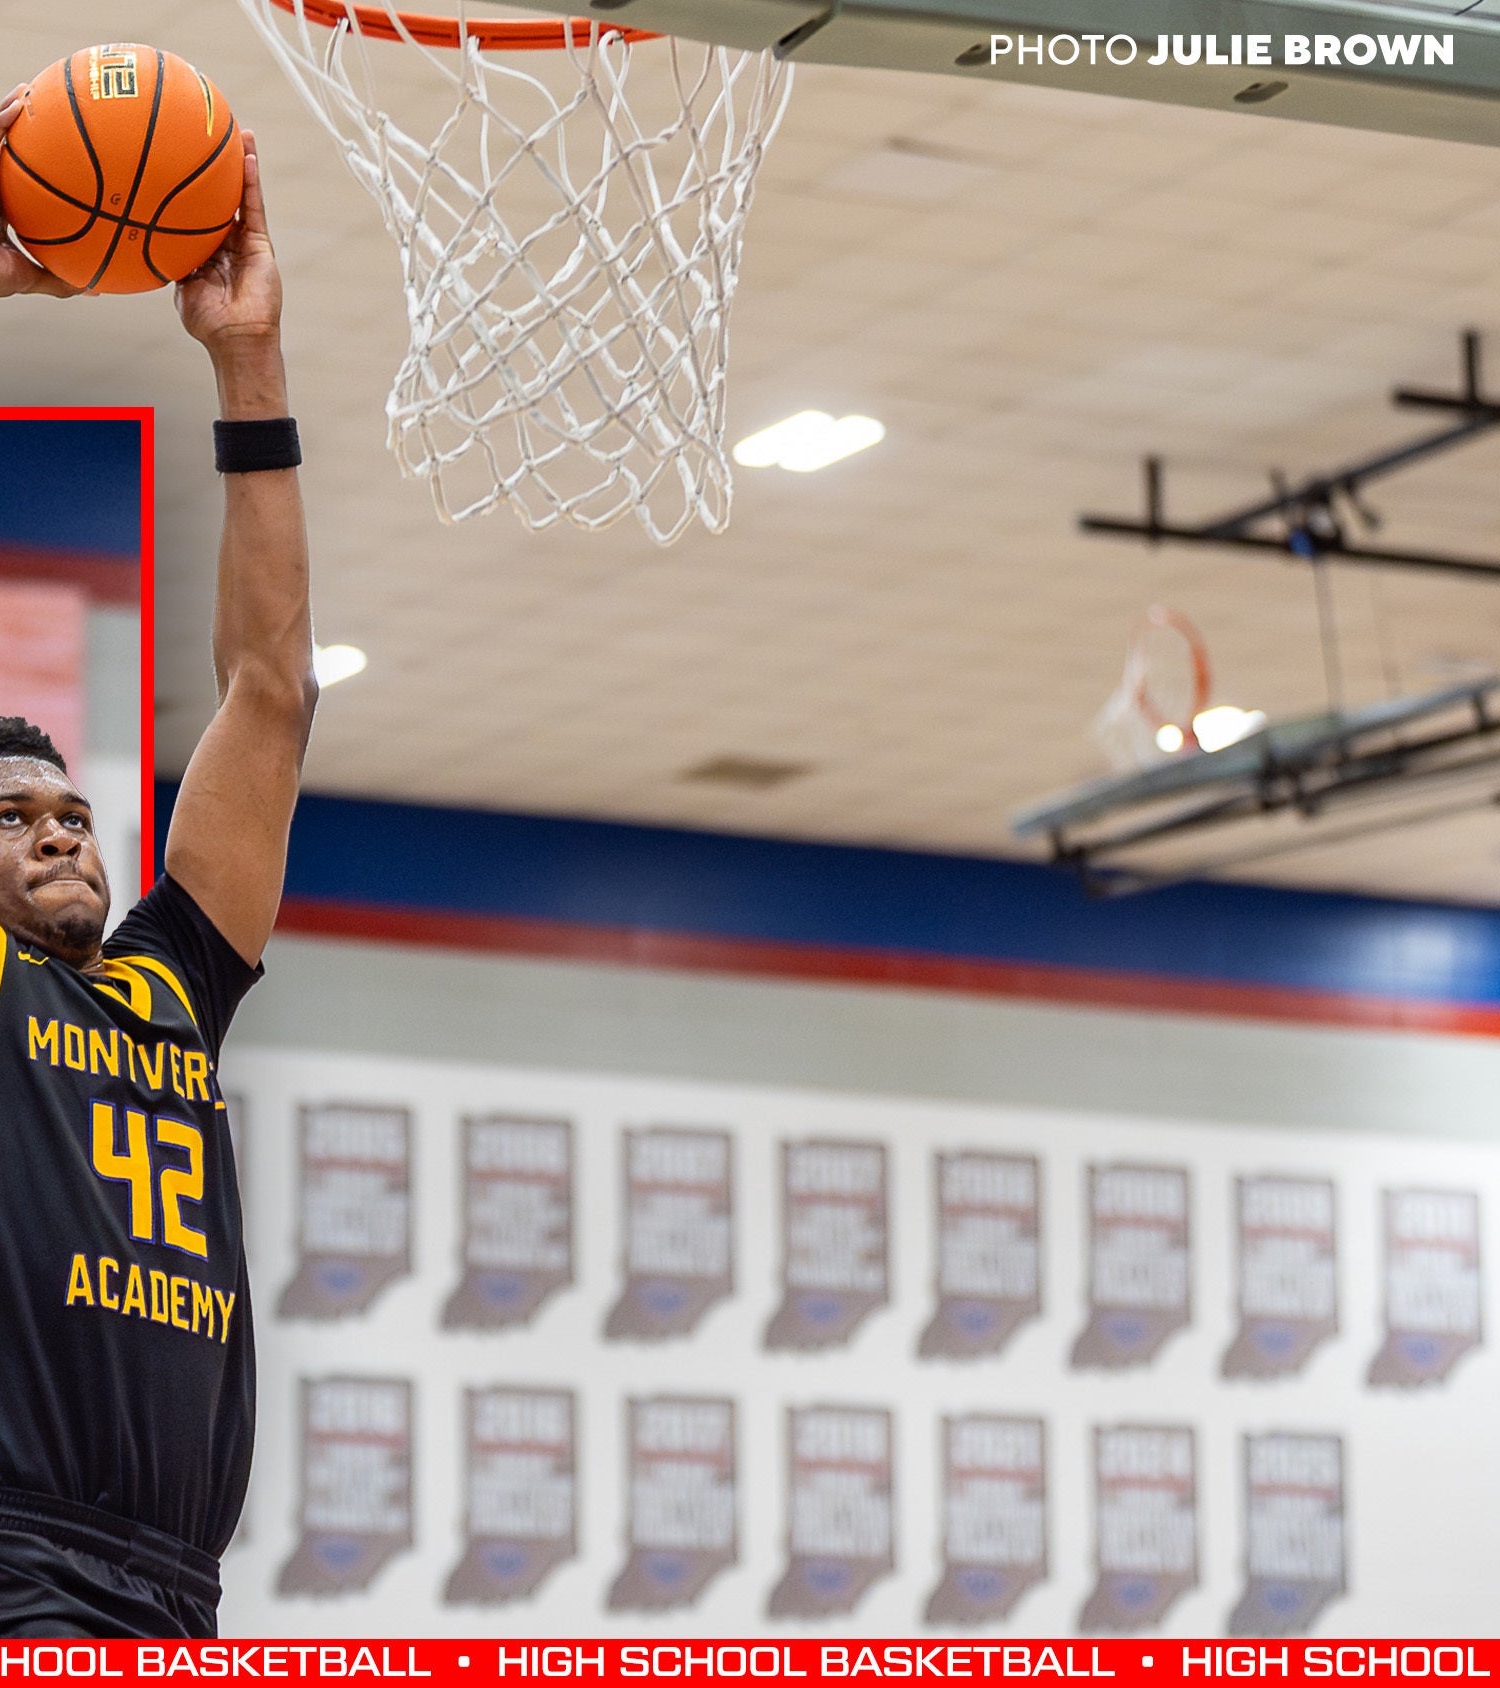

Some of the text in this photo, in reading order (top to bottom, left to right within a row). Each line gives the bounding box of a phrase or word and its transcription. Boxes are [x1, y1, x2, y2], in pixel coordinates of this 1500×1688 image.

[26, 1014, 226, 1111] MONTVER
[88, 1098, 210, 1262] 42
[65, 1252, 237, 1346] ACADEMY
